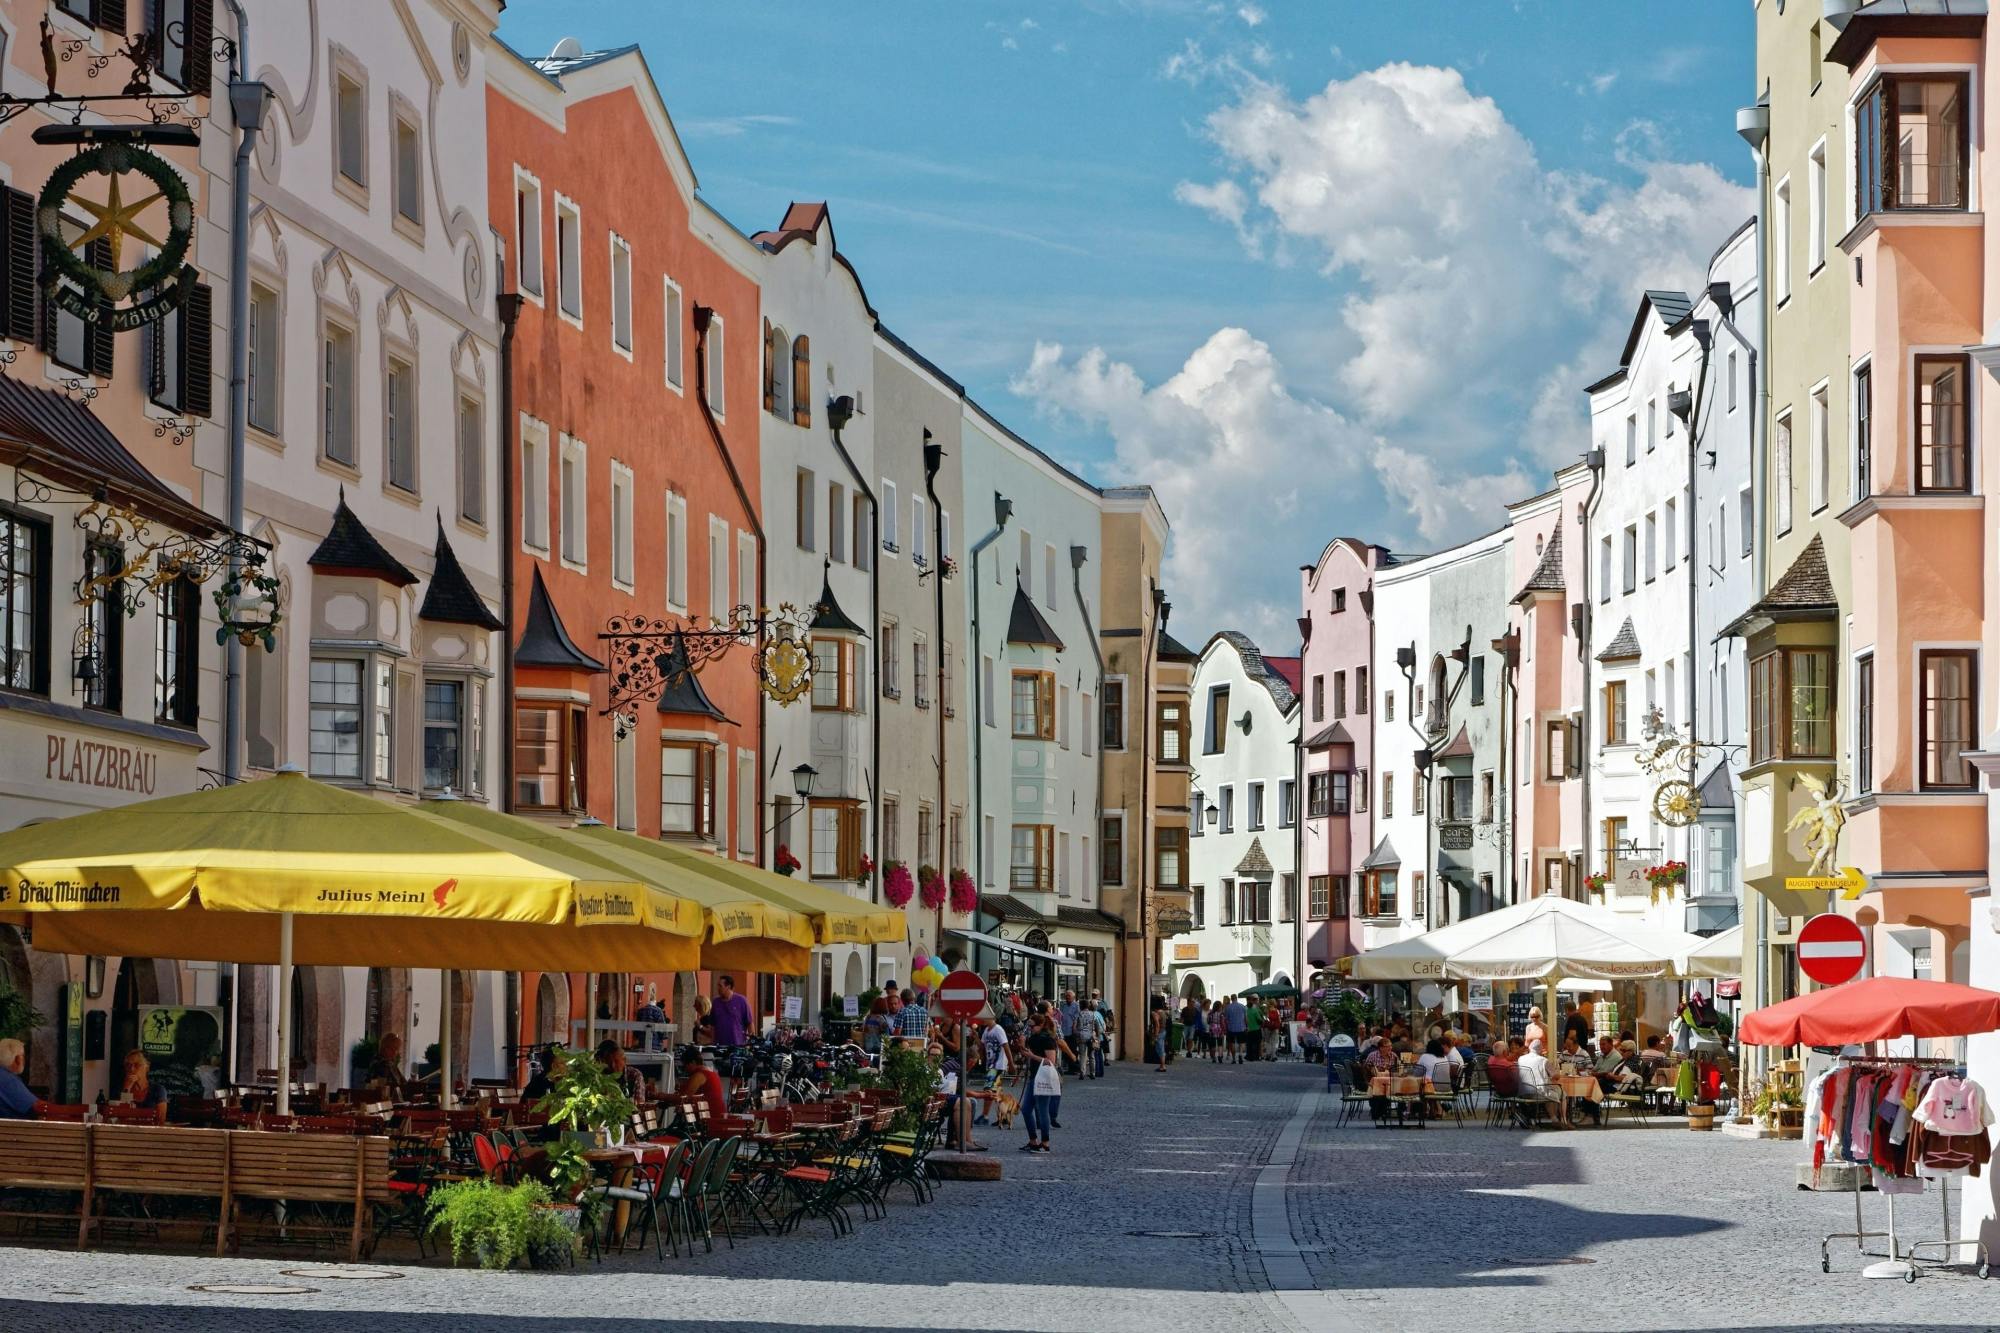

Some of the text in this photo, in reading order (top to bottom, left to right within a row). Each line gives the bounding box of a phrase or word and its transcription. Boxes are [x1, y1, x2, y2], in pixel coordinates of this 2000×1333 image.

[46, 734, 157, 795] PLATZBRÄU
[19, 879, 53, 903] Bräu
[54, 881, 120, 903] München
[317, 889, 425, 903] Julius Meinl
[1494, 966, 1544, 977] Konditorei
